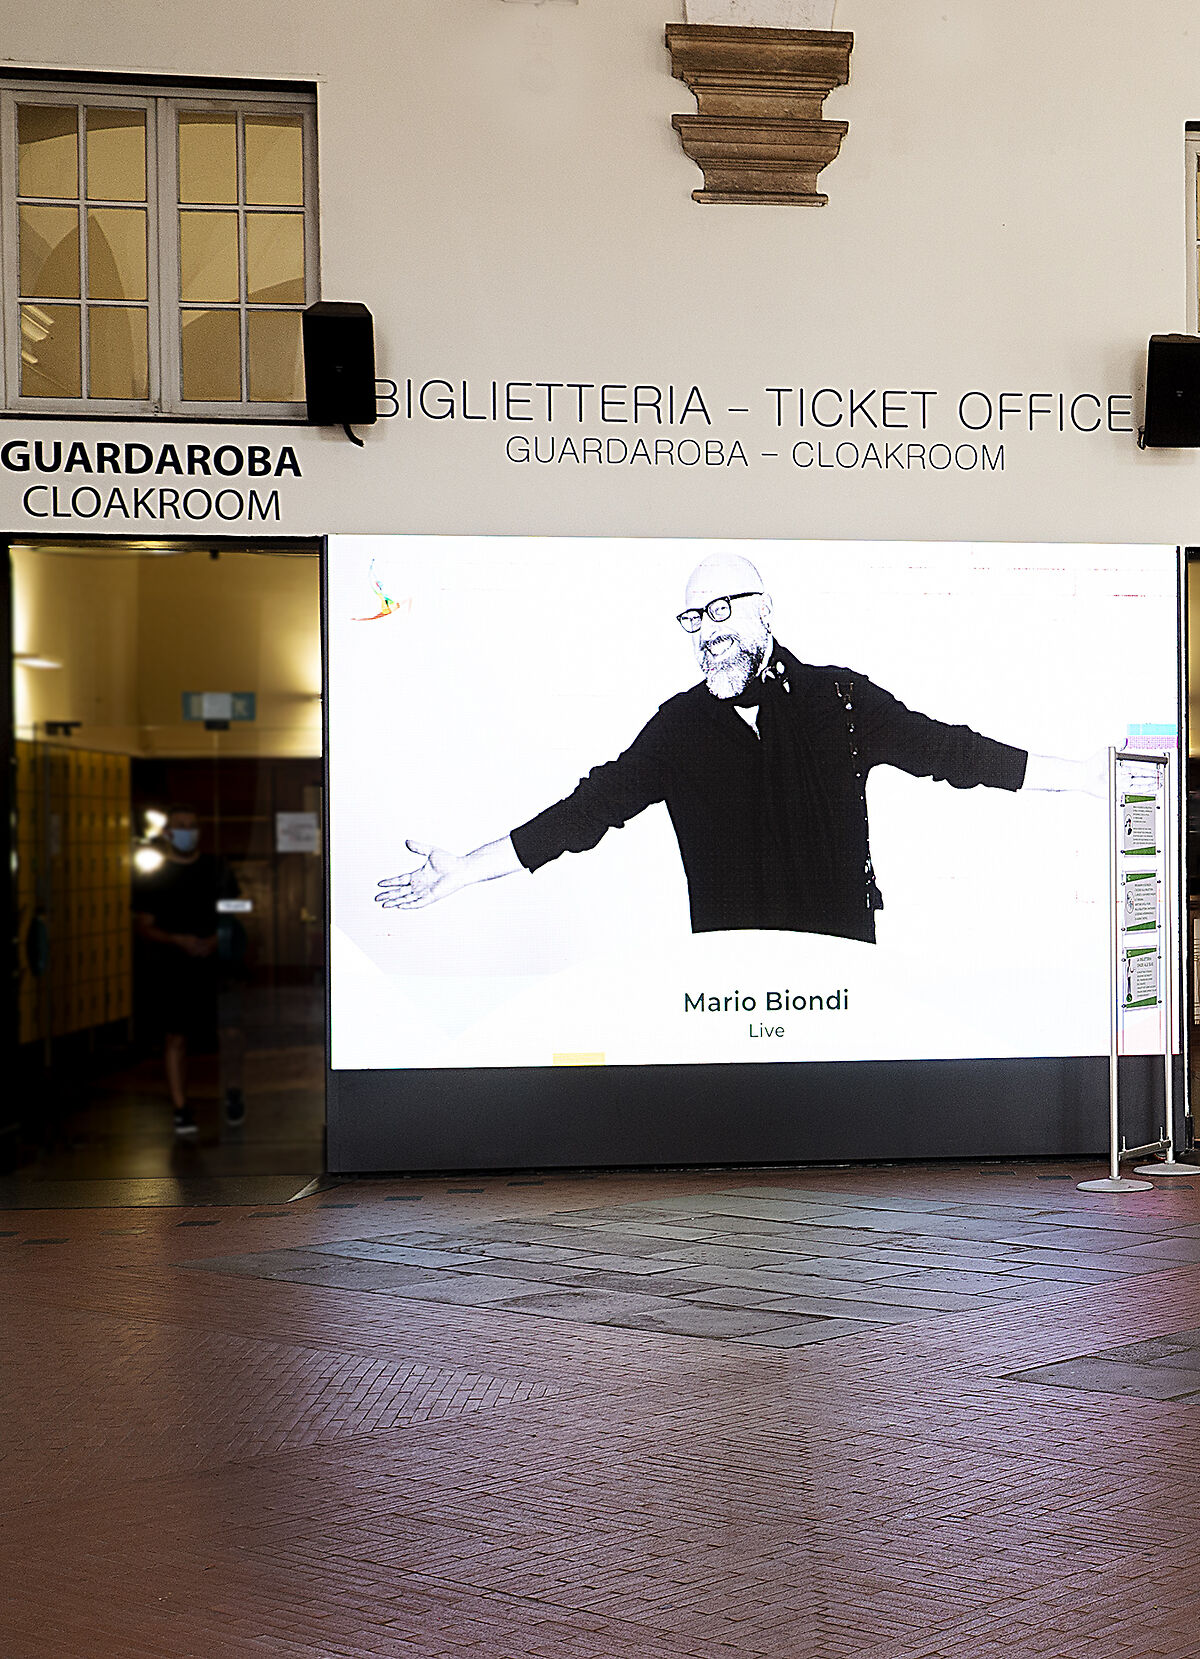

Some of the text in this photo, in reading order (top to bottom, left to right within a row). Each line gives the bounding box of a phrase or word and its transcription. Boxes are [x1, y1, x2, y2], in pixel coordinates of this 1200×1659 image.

[376, 378, 711, 426] BIGLIETTERIA
[766, 387, 937, 430] TICKET
[958, 391, 1136, 434] OFFICE
[0, 440, 303, 478] GUARDAROBA
[506, 436, 749, 467] GUARDAROBA
[792, 442, 1005, 472] CLOAKROOM
[23, 484, 281, 521] CLOAKROOM
[684, 988, 849, 1013] Mario Biondi
[749, 1023, 785, 1038] Live
